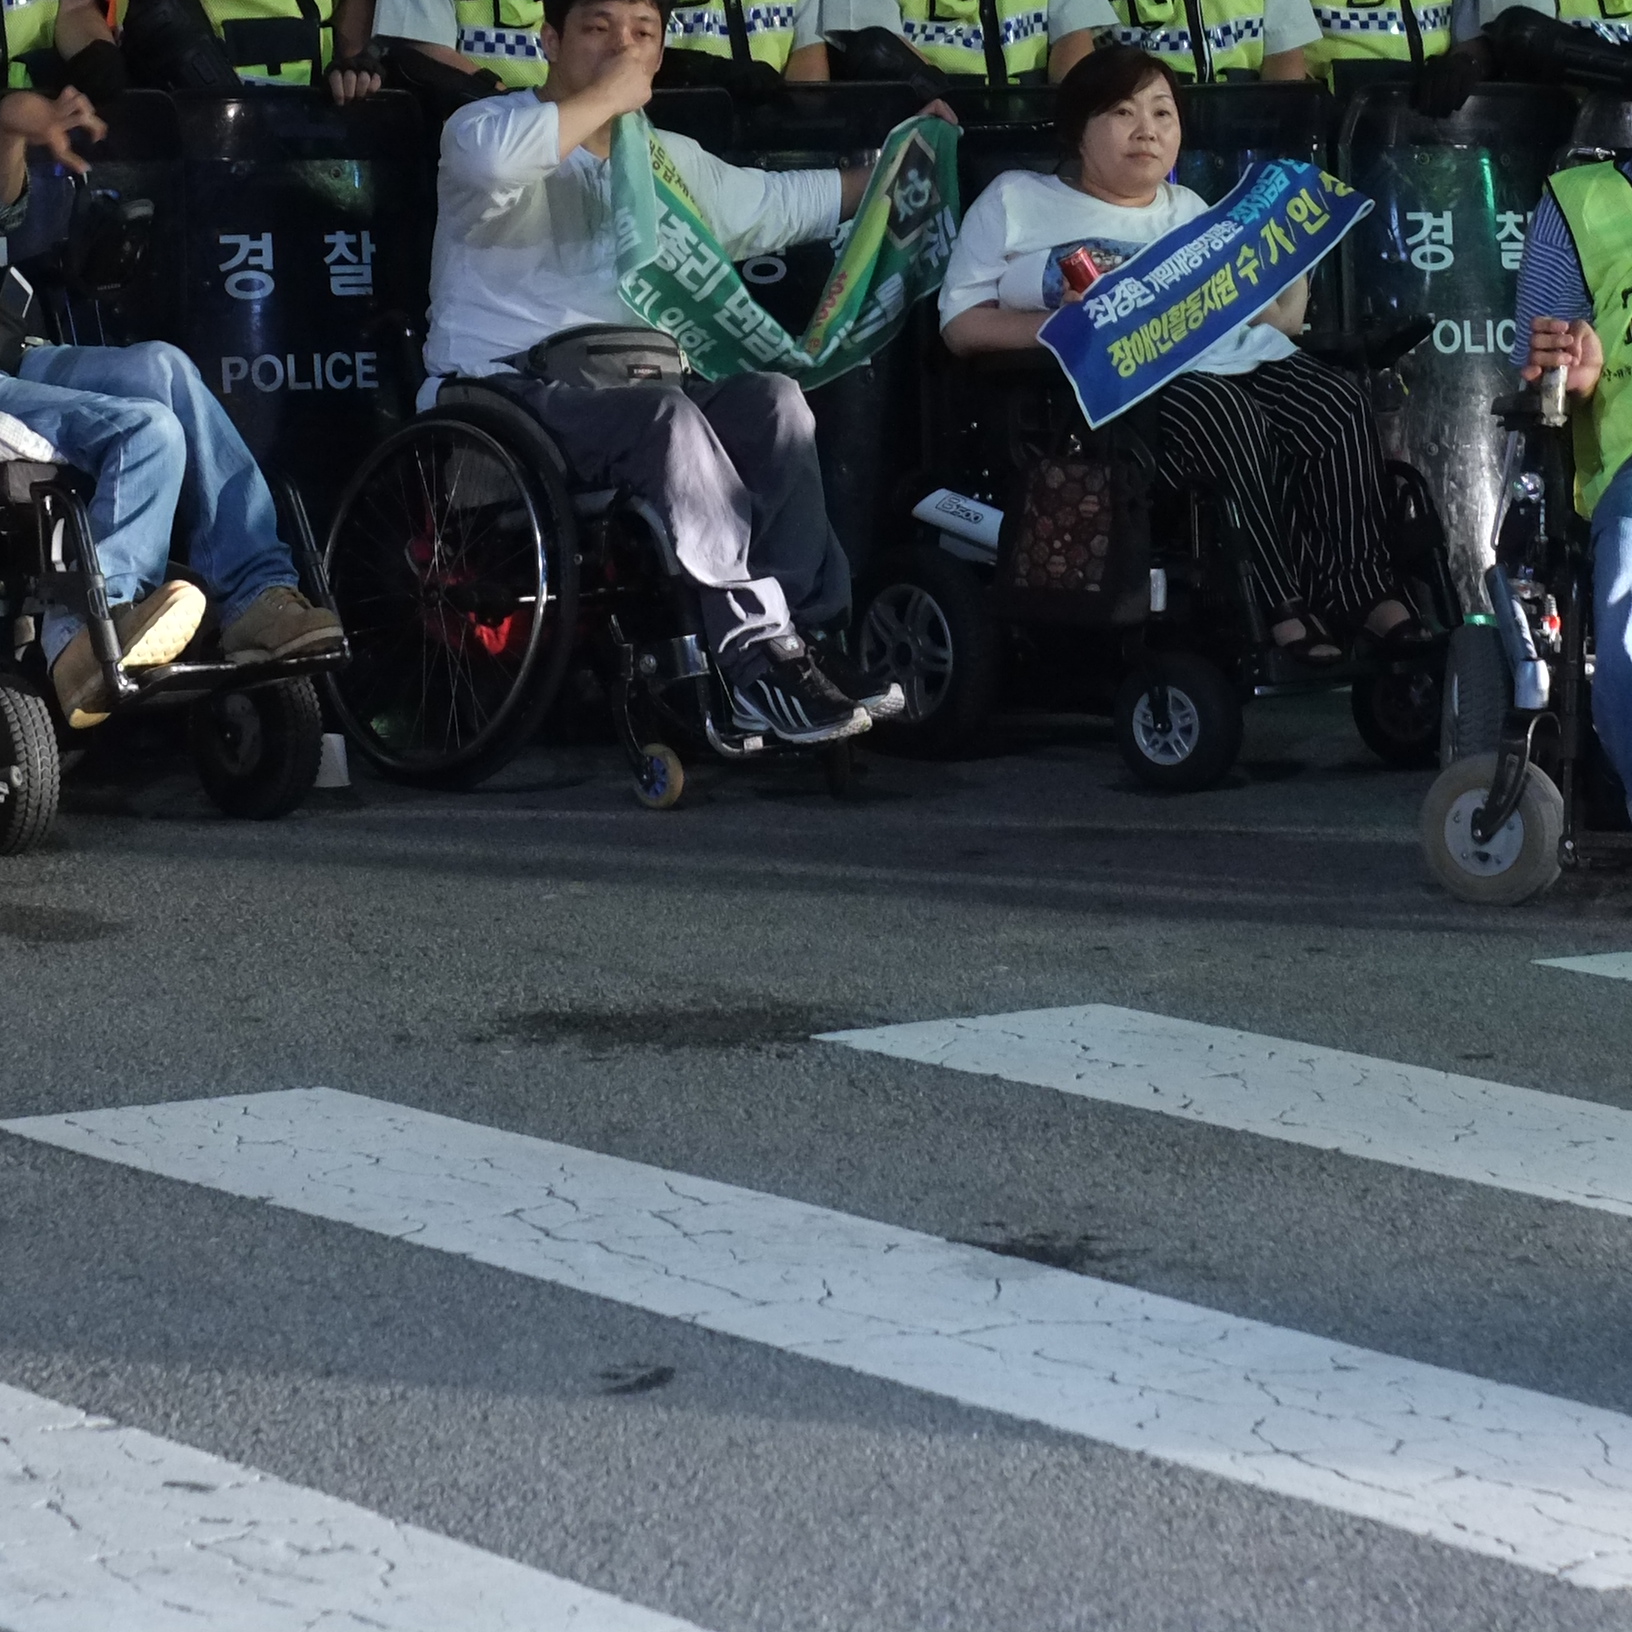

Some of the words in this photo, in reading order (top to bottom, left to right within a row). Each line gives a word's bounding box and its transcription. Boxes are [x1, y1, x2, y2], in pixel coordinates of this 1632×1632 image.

[1082, 276, 1156, 330] 최경환
[1225, 164, 1292, 227] 최저임금
[220, 351, 380, 395] POLICE
[1106, 263, 1241, 379] 장애인활동지원
